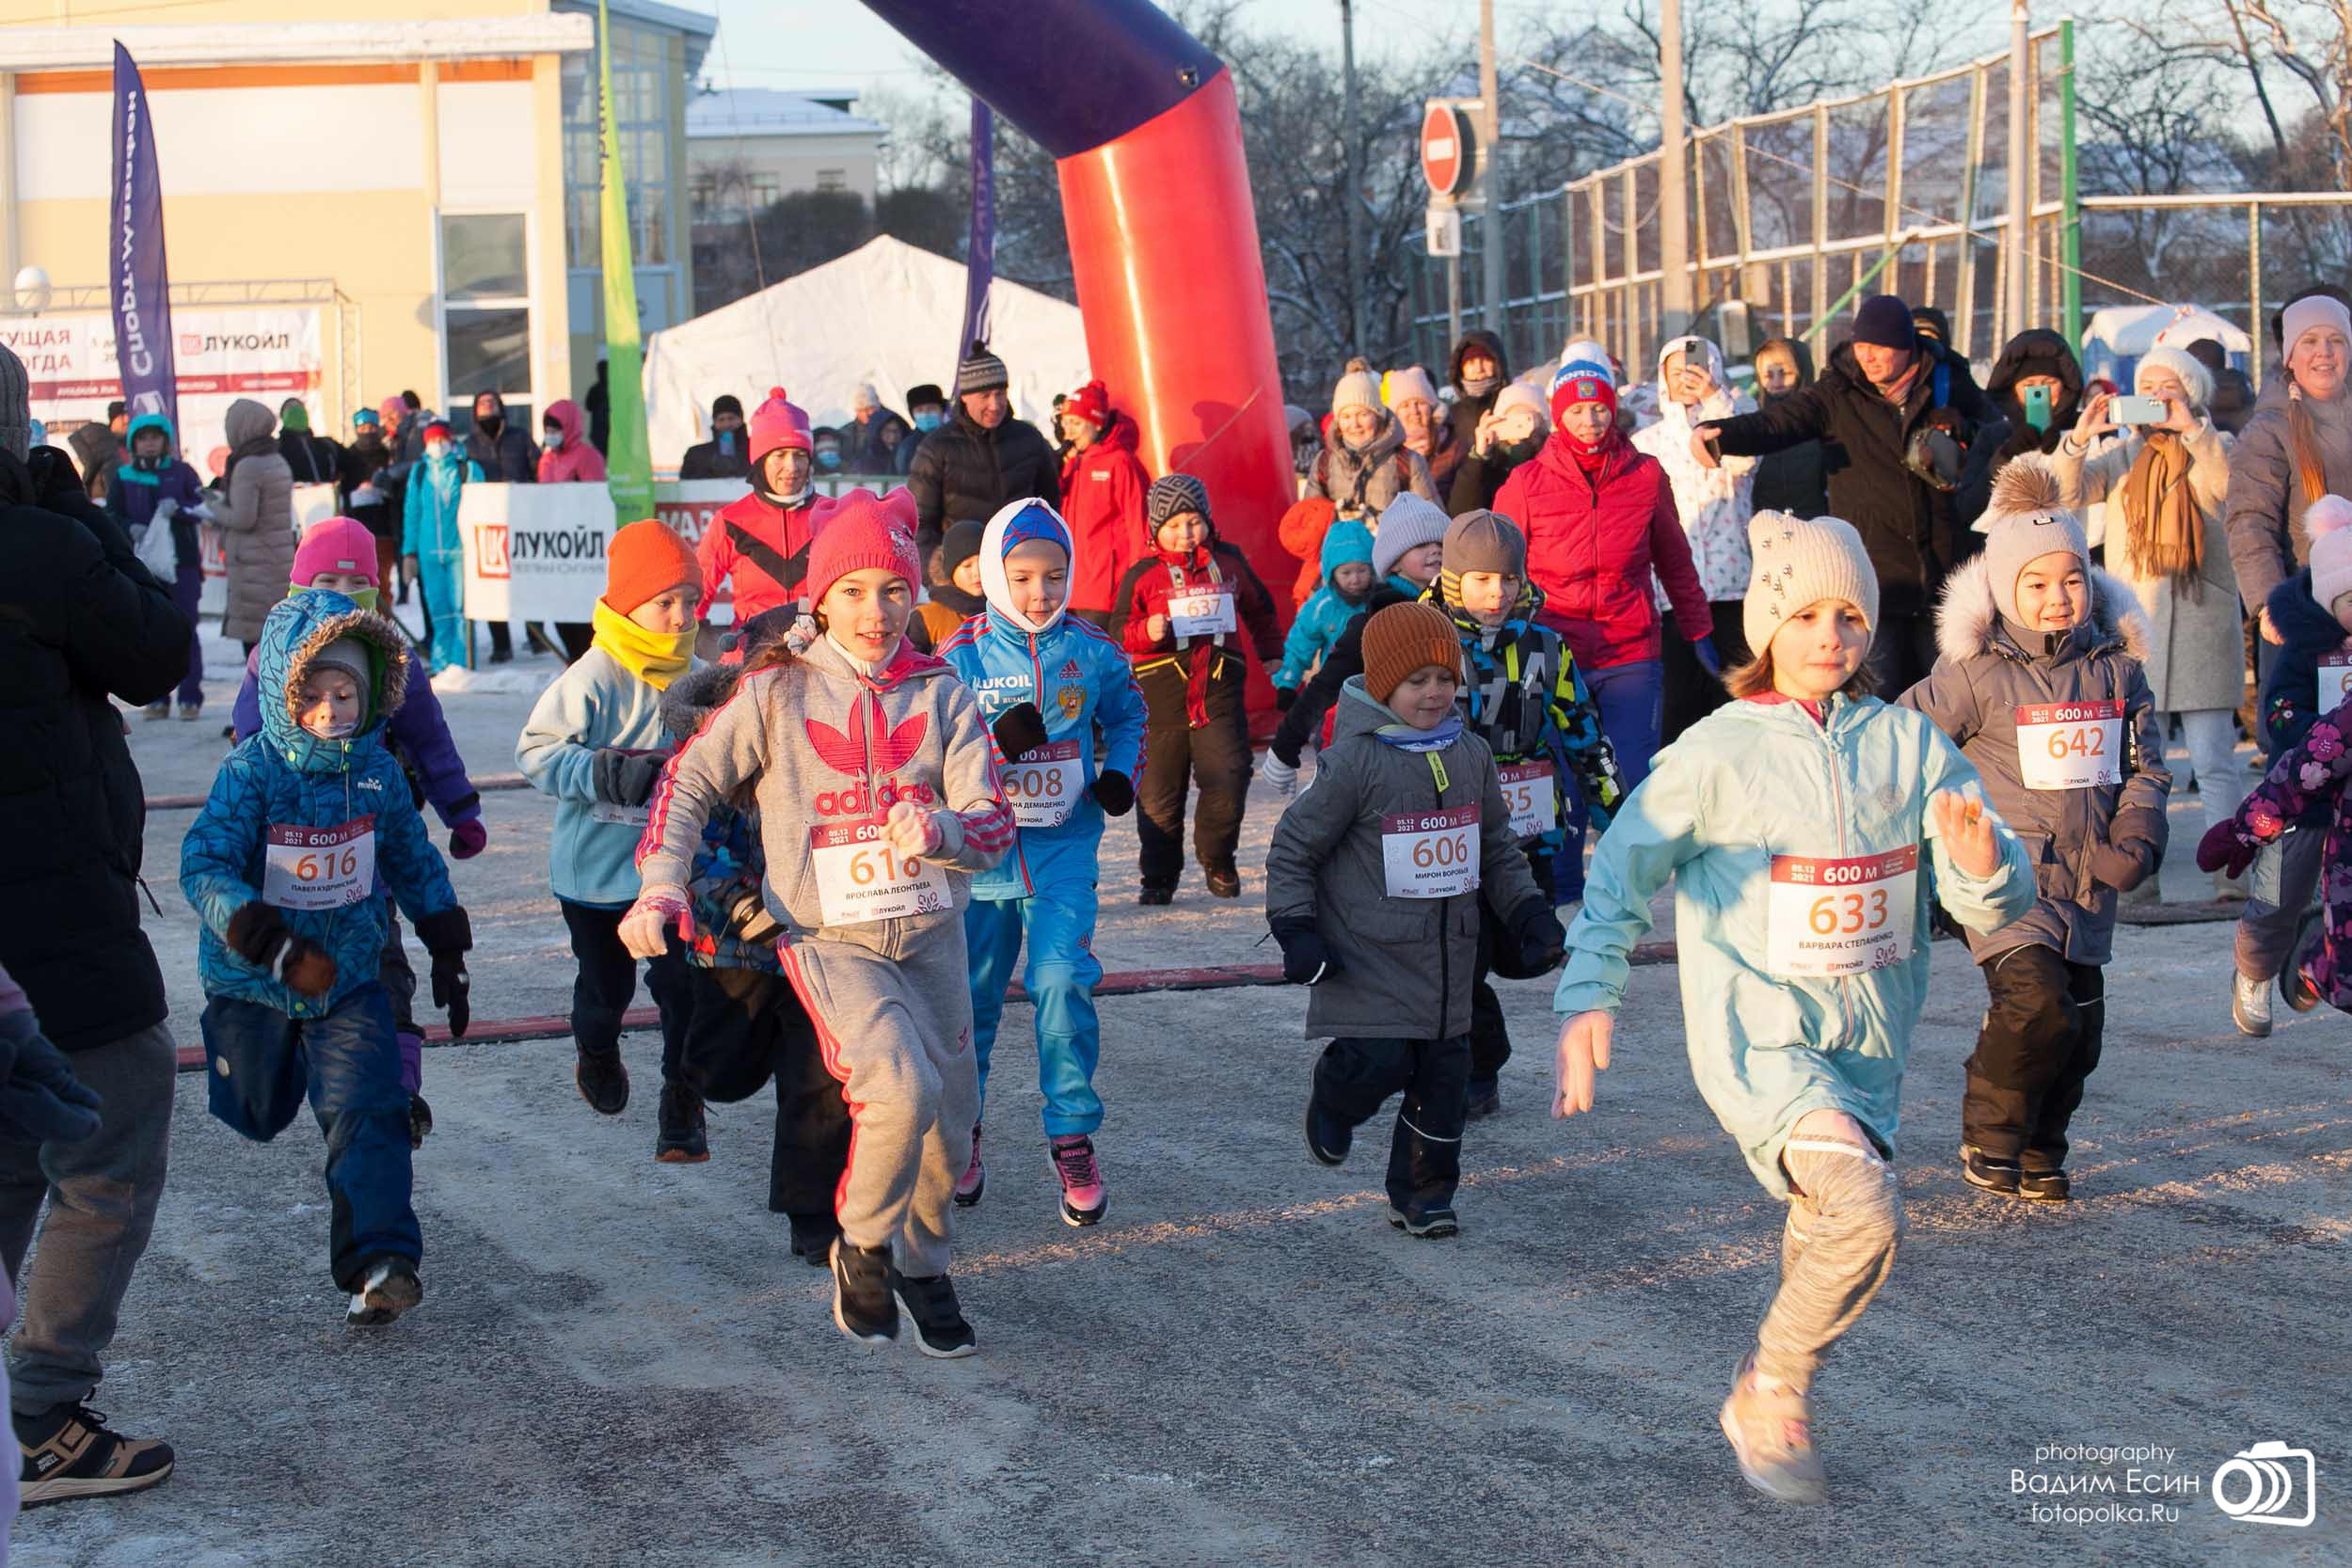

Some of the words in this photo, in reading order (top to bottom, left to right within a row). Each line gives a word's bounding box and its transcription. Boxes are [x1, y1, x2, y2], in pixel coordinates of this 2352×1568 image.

[204, 333, 289, 352] ЛУКОЙЛ
[512, 523, 604, 559] ЛУКОЙЛ
[1187, 598, 1220, 617] 637
[2055, 707, 2081, 721] 600
[2048, 727, 2105, 759] 642
[1003, 768, 1063, 798] 608
[814, 777, 934, 816] adidas
[1498, 785, 1532, 813] 35
[828, 828, 849, 837] 05.12
[856, 825, 881, 840] 60
[1421, 816, 1447, 830] 600
[310, 833, 338, 845] 600
[829, 836, 850, 845] 2021
[1413, 832, 1468, 868] 606
[296, 846, 358, 882] 616
[1415, 871, 1441, 880] МИРОН
[1823, 865, 1861, 883] 600
[292, 884, 316, 893] ПАВЕЛ
[891, 881, 931, 895] ЛЕОНТЬЕВА
[1808, 888, 1888, 935] 633
[1799, 941, 1843, 950] ВАРВАРА
[1845, 931, 1894, 949] СТЕПАНЕНКО
